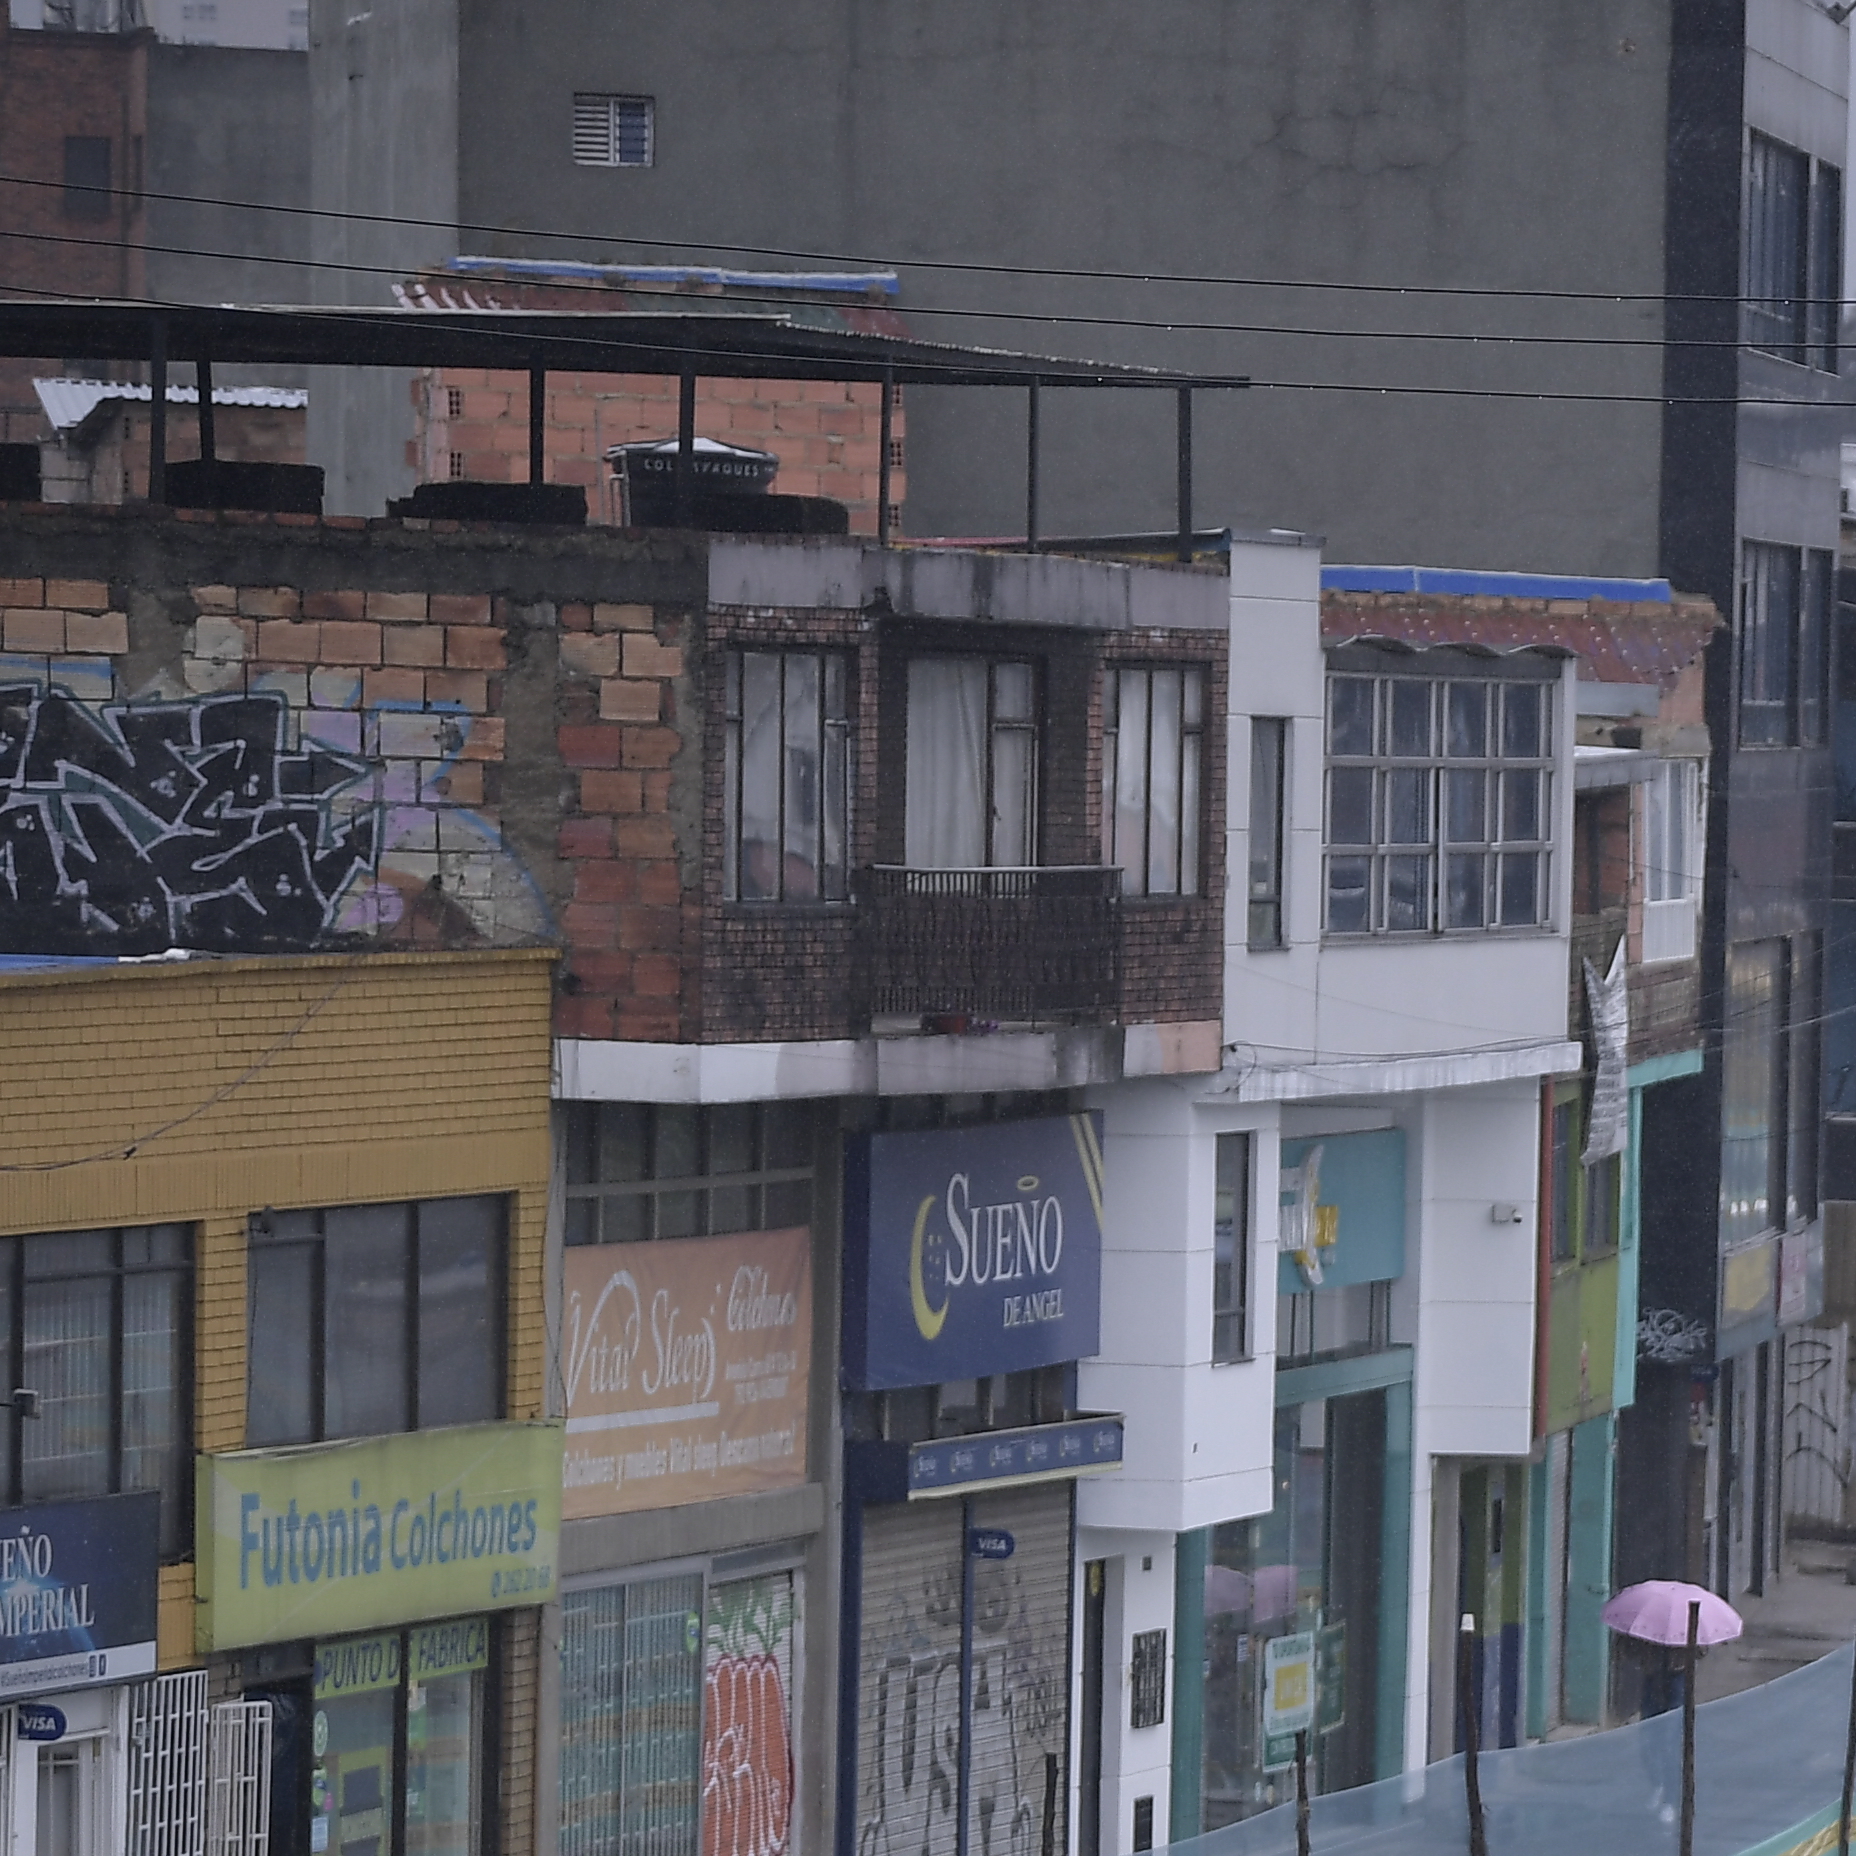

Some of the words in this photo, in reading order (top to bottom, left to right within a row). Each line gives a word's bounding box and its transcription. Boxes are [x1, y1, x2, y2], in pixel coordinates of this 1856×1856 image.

[565, 1270, 642, 1408] Vital
[1004, 1296, 1021, 1327] DE
[1023, 1288, 1064, 1323] ANGEL
[240, 1478, 383, 1590] Futonia
[389, 1488, 538, 1571] Colchones
[979, 1537, 1007, 1550] VISA
[321, 1641, 383, 1691] PUNTO
[387, 1636, 400, 1680] D
[418, 1621, 486, 1674] FABRICA
[22, 1714, 56, 1732] VISA
